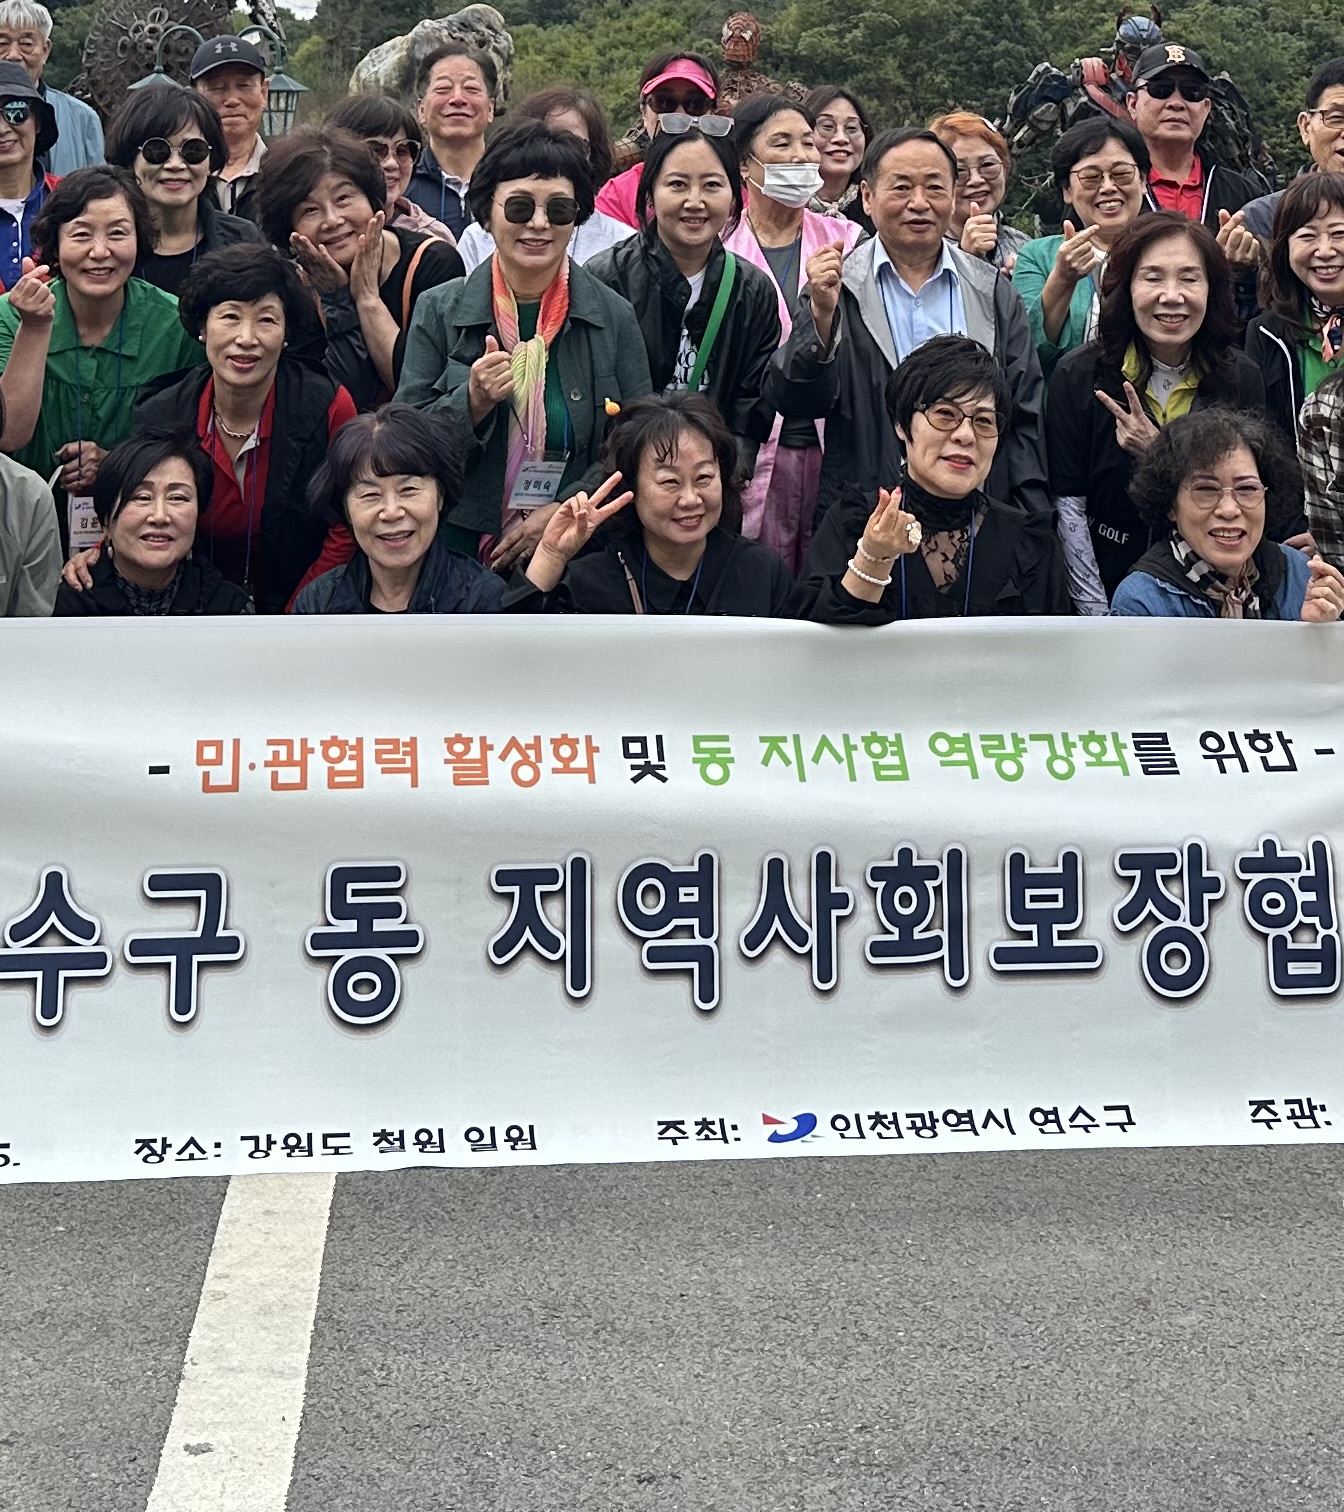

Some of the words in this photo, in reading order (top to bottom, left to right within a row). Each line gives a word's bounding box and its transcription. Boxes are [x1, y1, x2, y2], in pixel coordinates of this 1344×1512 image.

[1098, 523, 1130, 545] GOLF
[195, 734, 419, 794] 민·관협력
[444, 733, 600, 788] 활성화
[622, 734, 669, 784] 및
[692, 735, 735, 786] 동
[759, 731, 911, 782] 지사협
[927, 730, 1181, 782] 역량강화를
[1199, 728, 1298, 774] 위한
[304, 858, 428, 1028] 동
[657, 1117, 741, 1145] 주최:
[830, 1108, 1016, 1139] 인천광역시
[1029, 1105, 1136, 1134] 연수구
[1248, 1097, 1332, 1130] 주관:
[134, 1136, 221, 1164] 장소:
[240, 1132, 353, 1159] 강원도
[373, 1128, 445, 1154] 철원
[464, 1125, 537, 1152] 일원
